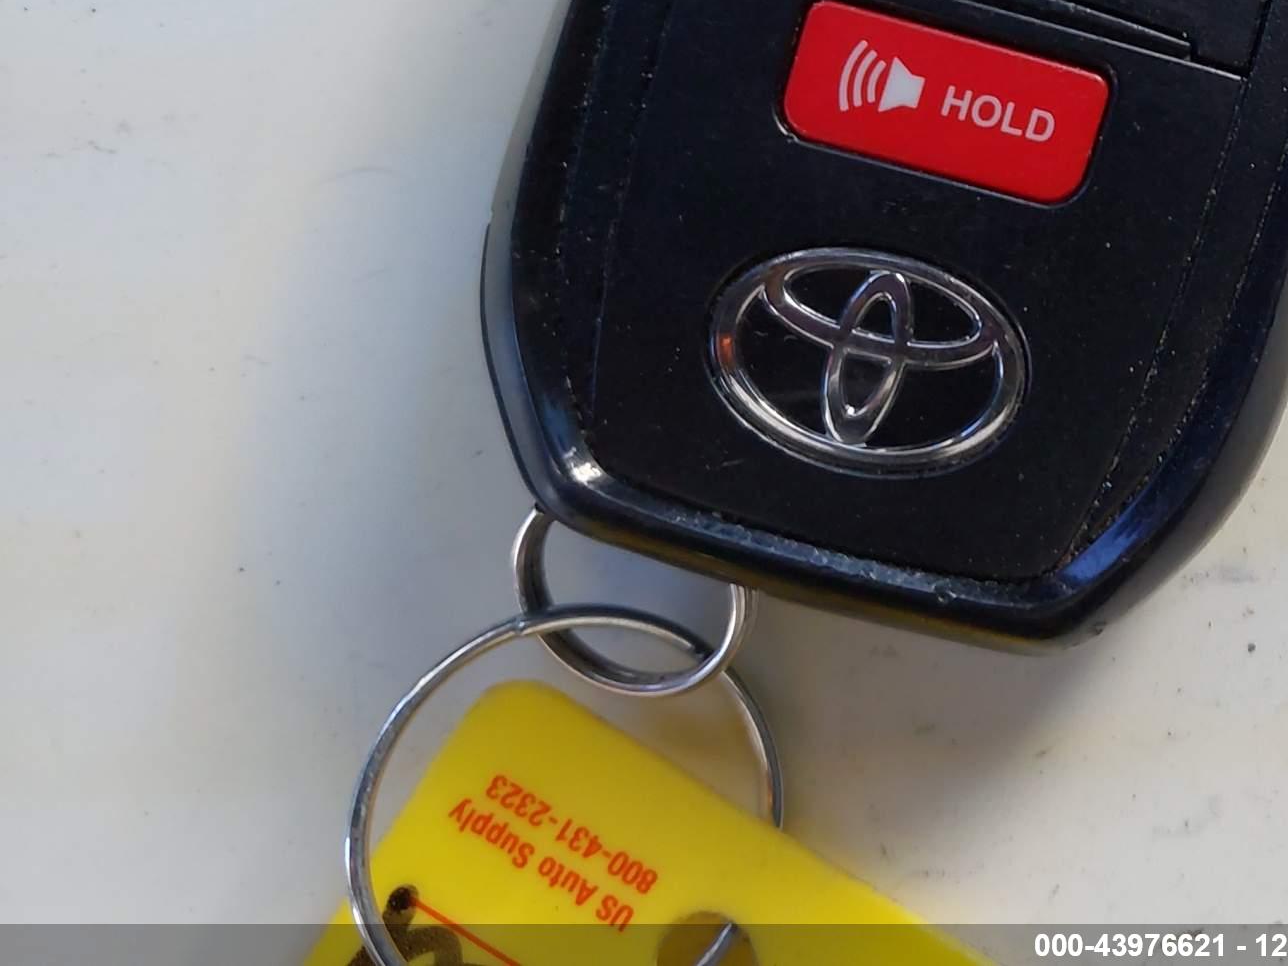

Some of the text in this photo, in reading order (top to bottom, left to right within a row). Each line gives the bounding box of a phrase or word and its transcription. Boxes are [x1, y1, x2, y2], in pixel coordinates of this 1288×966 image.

[940, 85, 1055, 142] HOLD
[448, 798, 634, 932] US Auto Supply
[485, 775, 658, 894] 800-431-2323
